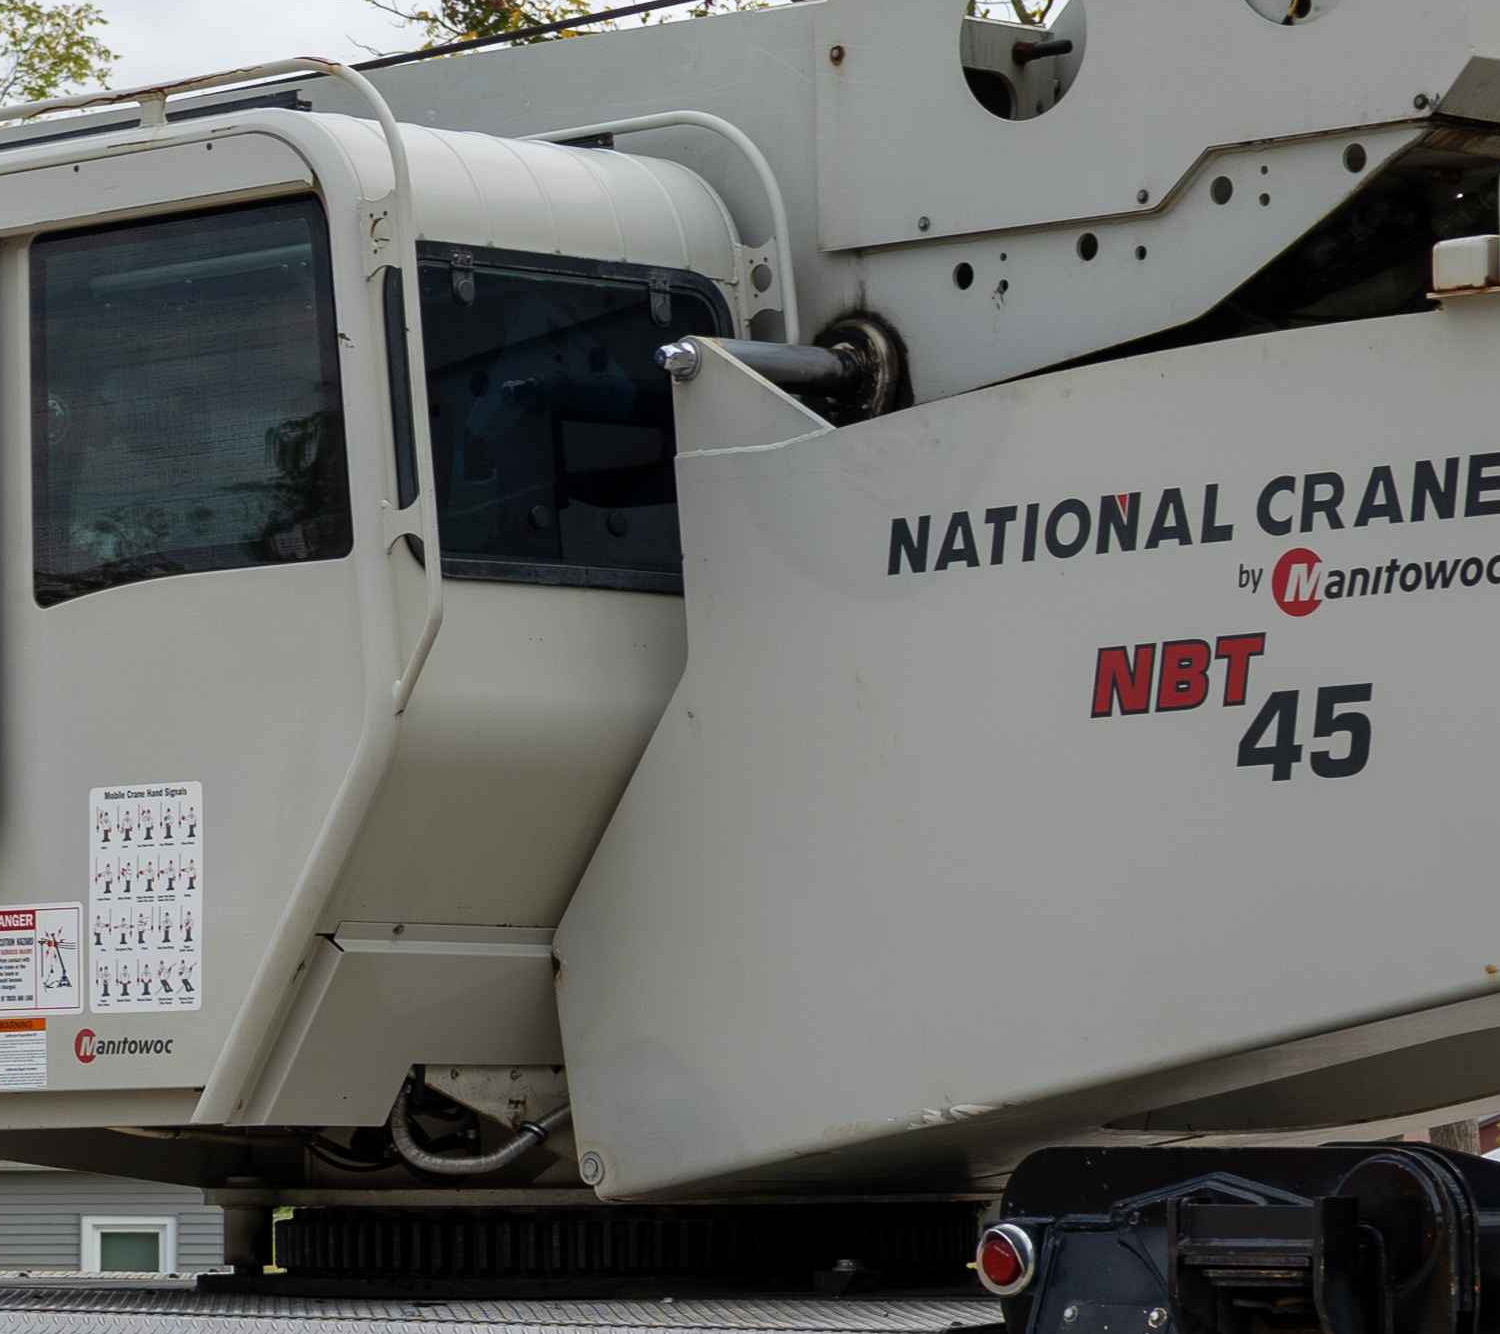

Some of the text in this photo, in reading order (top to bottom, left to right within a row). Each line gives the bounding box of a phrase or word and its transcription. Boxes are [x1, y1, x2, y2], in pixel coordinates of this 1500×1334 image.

[887, 483, 1234, 576] NATIONAL
[1238, 563, 1263, 594] by
[1090, 632, 1266, 719] NBT
[1237, 682, 1374, 782] 45
[104, 787, 187, 800] Mobile Crane Hand Signals
[74, 1028, 173, 1063] Manitowoc
